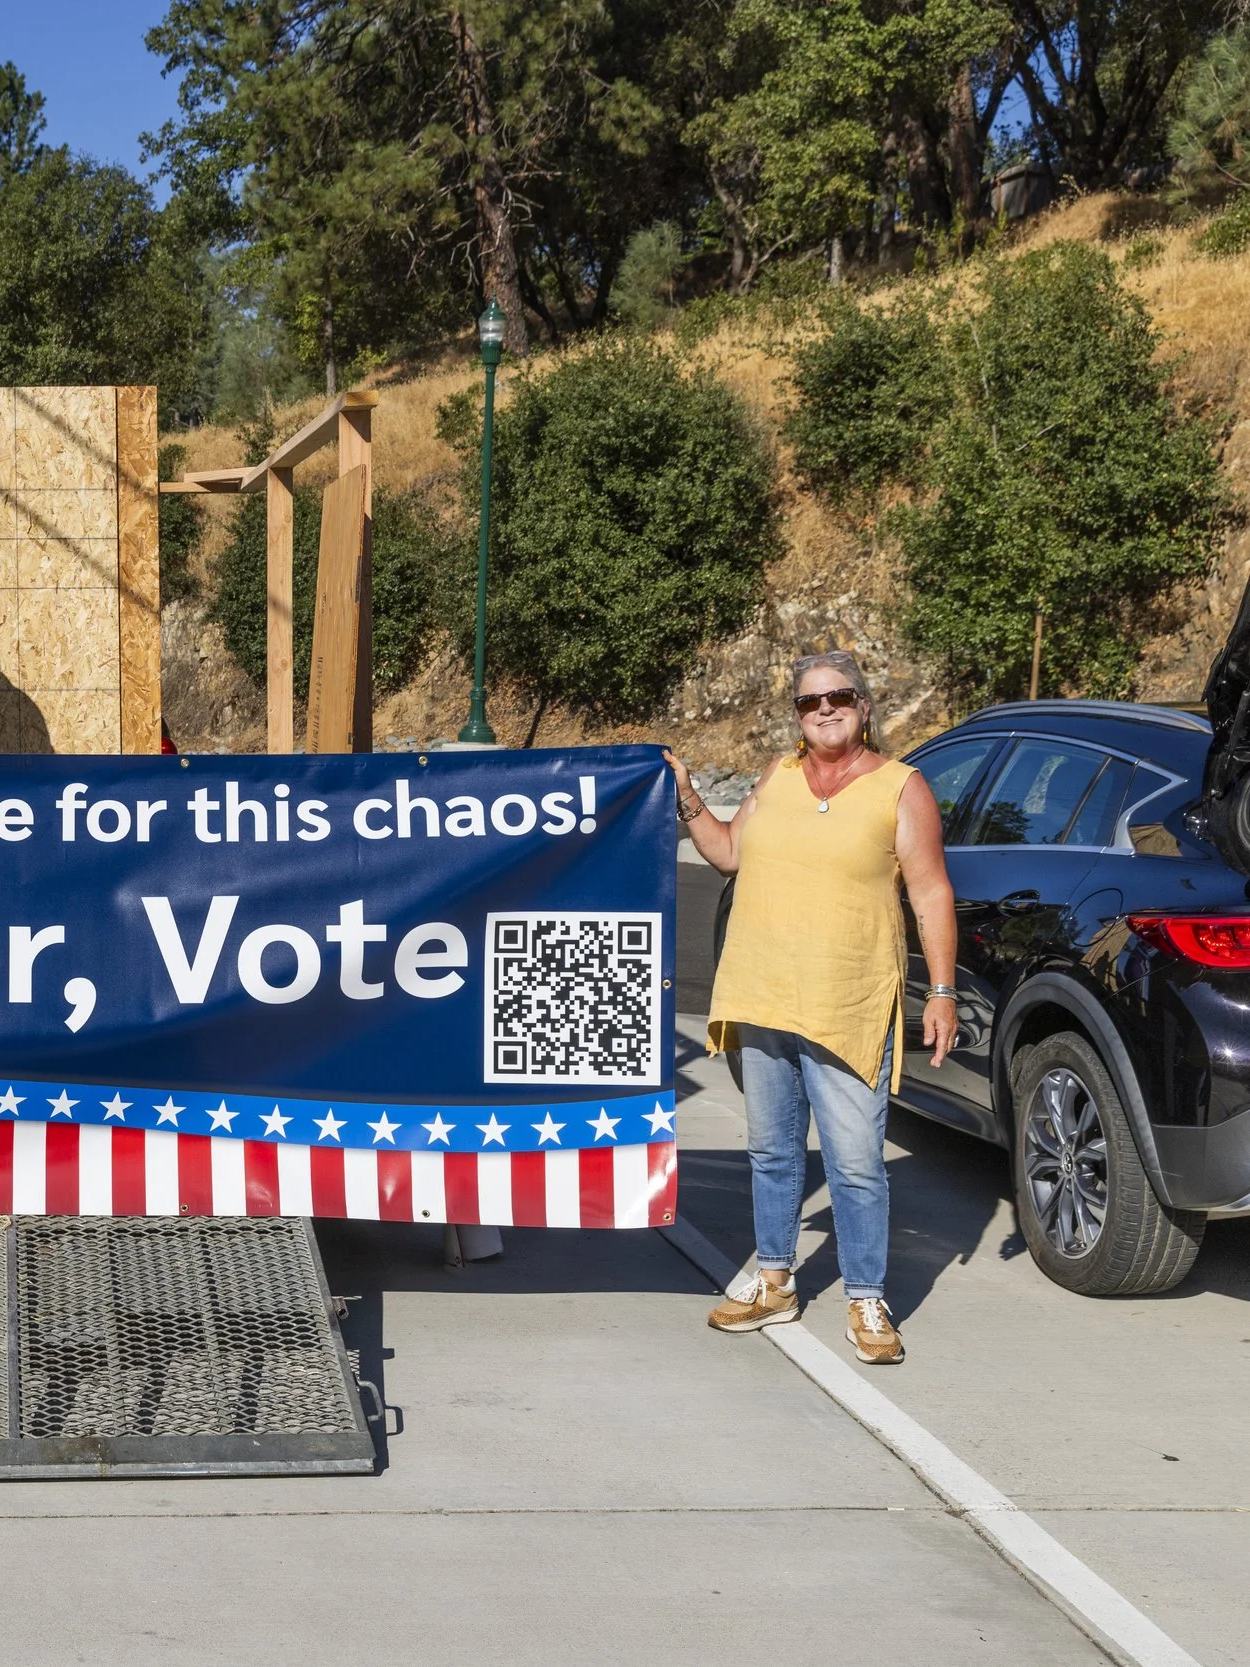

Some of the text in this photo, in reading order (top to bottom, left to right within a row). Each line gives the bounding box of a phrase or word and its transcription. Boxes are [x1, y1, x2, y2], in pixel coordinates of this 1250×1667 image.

[56, 783, 167, 842] for
[188, 782, 330, 842] this
[353, 776, 596, 839] chaos!
[141, 896, 468, 1004] Vote
